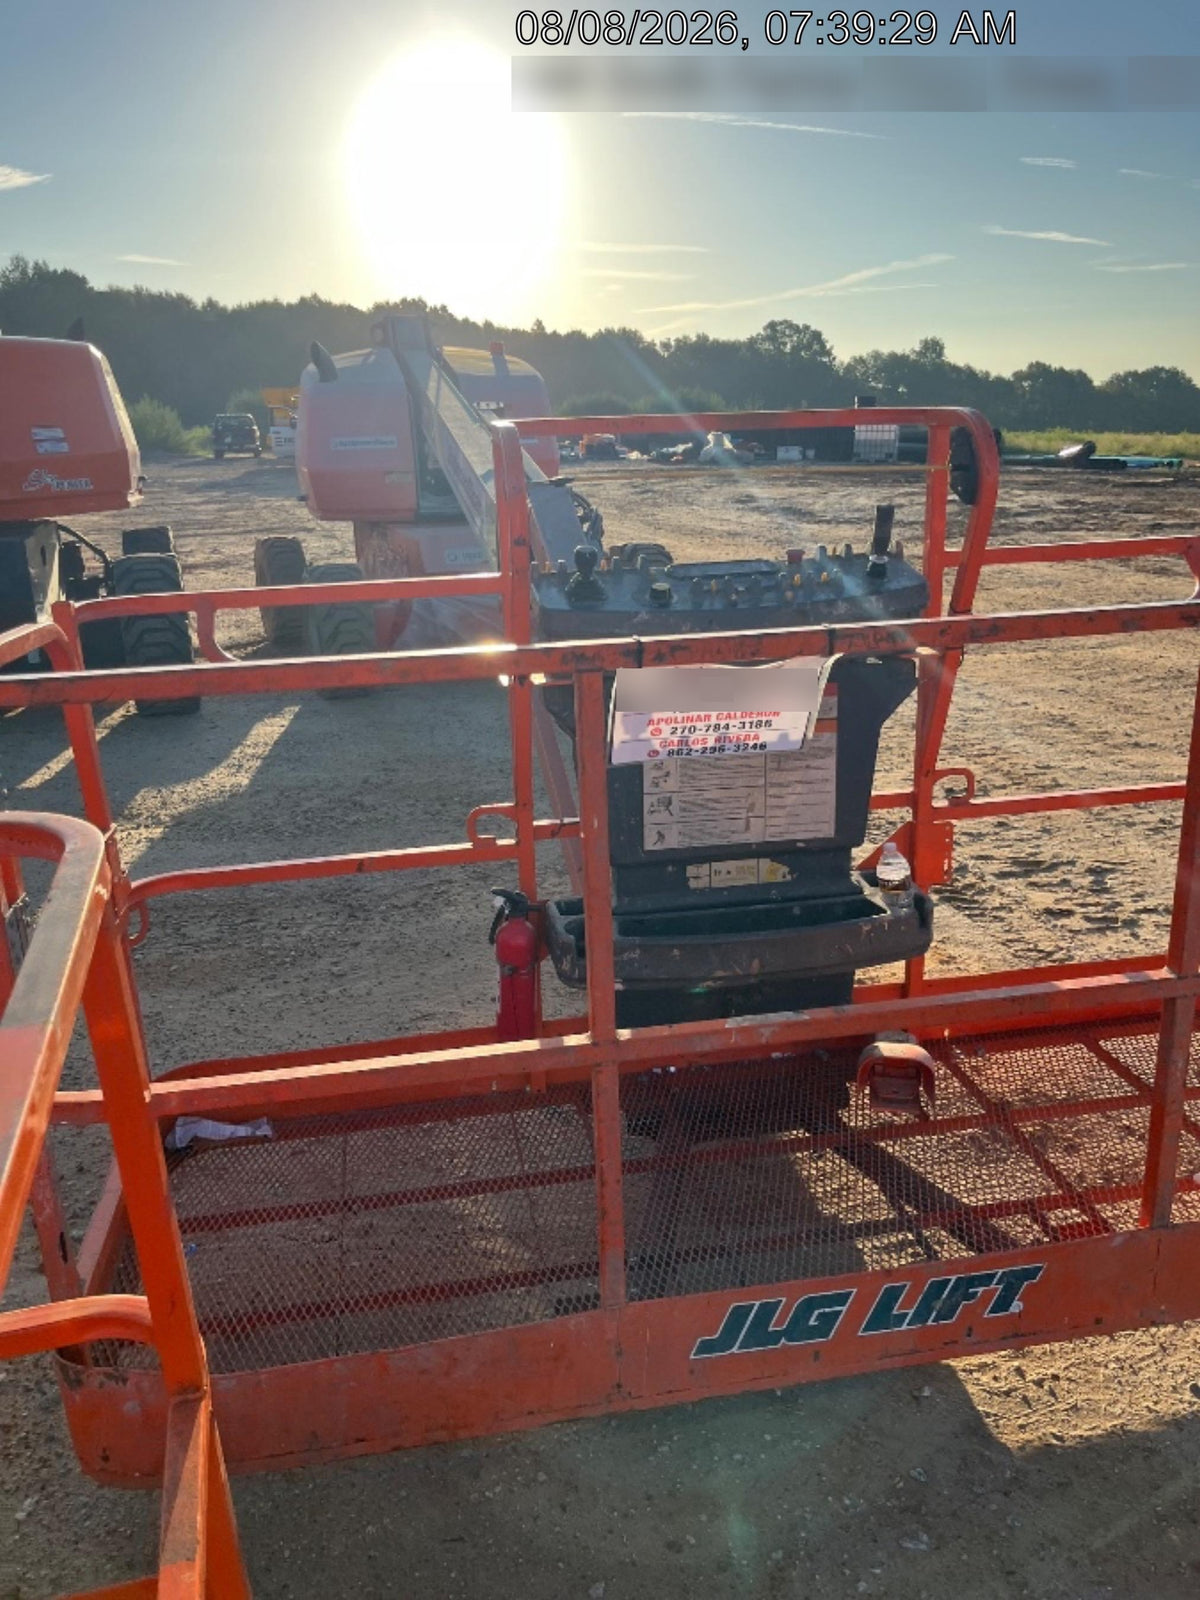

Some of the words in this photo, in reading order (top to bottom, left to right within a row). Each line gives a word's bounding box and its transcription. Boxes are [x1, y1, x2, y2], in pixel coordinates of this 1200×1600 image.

[646, 714, 712, 727] APOLINAR
[659, 737, 709, 749] CARLOS
[690, 1288, 857, 1359] JLG
[858, 1263, 1046, 1335] LIFT
